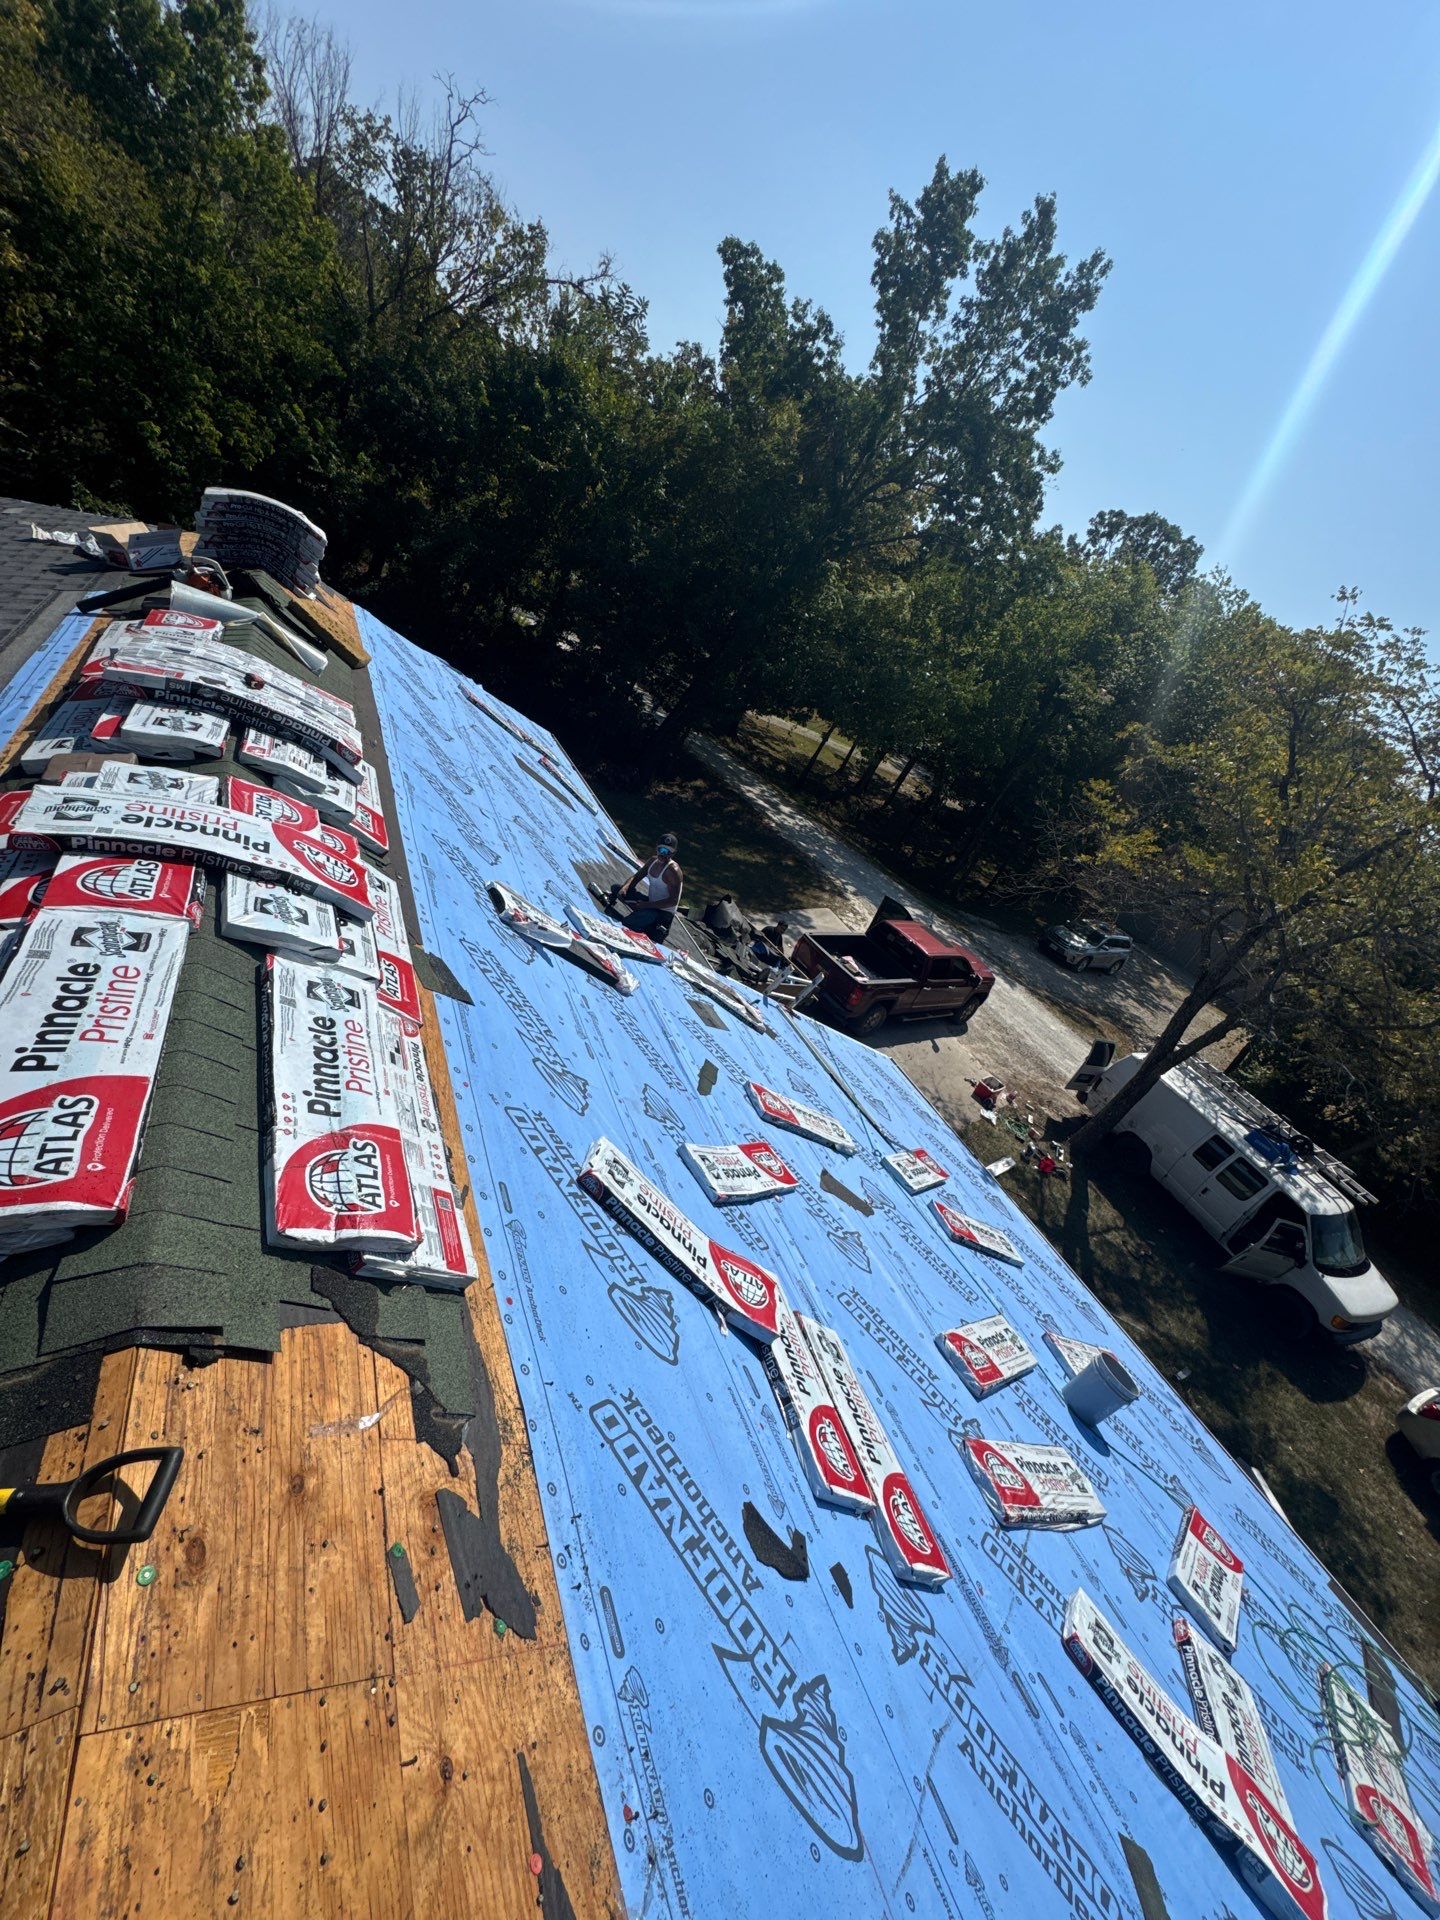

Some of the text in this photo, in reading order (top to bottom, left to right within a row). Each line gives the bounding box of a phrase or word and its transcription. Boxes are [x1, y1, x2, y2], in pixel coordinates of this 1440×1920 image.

[155, 690, 224, 713] Pinnacle
[228, 707, 277, 733] Pristine
[272, 713, 332, 747] Pinnacle
[71, 836, 176, 858] Pinnacle
[181, 849, 252, 875] Pristine
[121, 813, 270, 854] Pinnacle
[125, 802, 239, 832] Pristine
[128, 860, 160, 898] ATLAS
[376, 894, 395, 941] Pristine
[9, 962, 102, 1073] Pinnacle
[79, 965, 141, 1044] Pristine
[384, 961, 399, 1000] ATLAS
[303, 1016, 342, 1118] Pinnacle
[343, 1019, 373, 1096] Pristine
[411, 1041, 431, 1118] Pinnacle Pristine
[33, 1097, 95, 1176] ATLAS
[93, 1131, 104, 1162] Protection
[352, 1140, 384, 1211] ATLAS
[639, 1183, 693, 1240] Pristine
[605, 1197, 655, 1247] Pinnacle
[656, 1244, 693, 1284] Pristine
[637, 1192, 708, 1270] Pinnacle
[723, 1260, 764, 1291] ATLAS
[780, 1321, 812, 1397] Pinnac
[782, 1313, 814, 1380] Pristine
[837, 1290, 963, 1429] ROOFNADO
[848, 1284, 940, 1382] AnchorDeck
[978, 1329, 1006, 1347] Pinnacle
[832, 1368, 882, 1465] Pinnacle
[844, 1373, 882, 1446] Pristine
[620, 1387, 763, 1596] AnchorDeck
[1015, 1457, 1061, 1478] Pinnacle
[589, 1399, 798, 1710] ROOFNADO
[1127, 1660, 1201, 1754] Pristine
[1182, 1644, 1203, 1702] Pinnacle
[1097, 1674, 1154, 1758] Pinnacle
[1153, 1751, 1209, 1819] Pristine
[1126, 1676, 1226, 1802] Pinnacle
[1222, 1692, 1256, 1781] innacle
[628, 1703, 693, 1920] ROOFNADO Anchor
[957, 1734, 1096, 1920] AnchorDe
